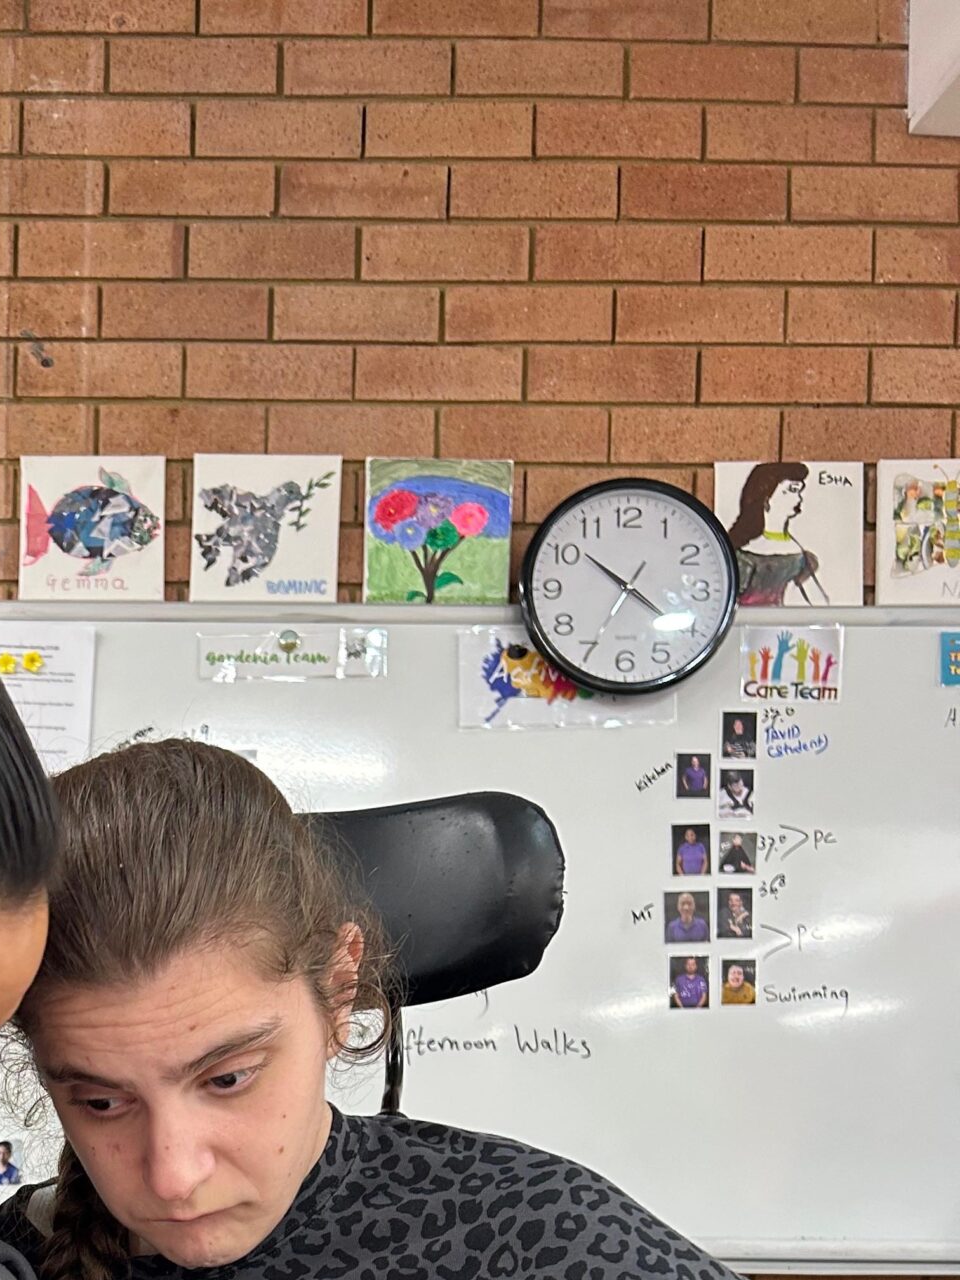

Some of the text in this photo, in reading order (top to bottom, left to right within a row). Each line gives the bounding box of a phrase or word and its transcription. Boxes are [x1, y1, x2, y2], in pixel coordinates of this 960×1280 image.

[581, 516, 600, 539] 11
[615, 506, 642, 529] 12
[660, 517, 668, 539] 1
[554, 543, 580, 565] 10
[679, 543, 700, 566] 2
[45, 576, 129, 592] Gemma
[542, 578, 562, 600] 9
[690, 579, 710, 602] 3
[553, 613, 574, 636] 8
[578, 640, 599, 663] 7
[615, 650, 635, 673] 6
[650, 642, 671, 664] 5
[743, 681, 838, 700] Care Team
[762, 984, 848, 1019] Swimming
[403, 1024, 592, 1065] fternoon Walks
